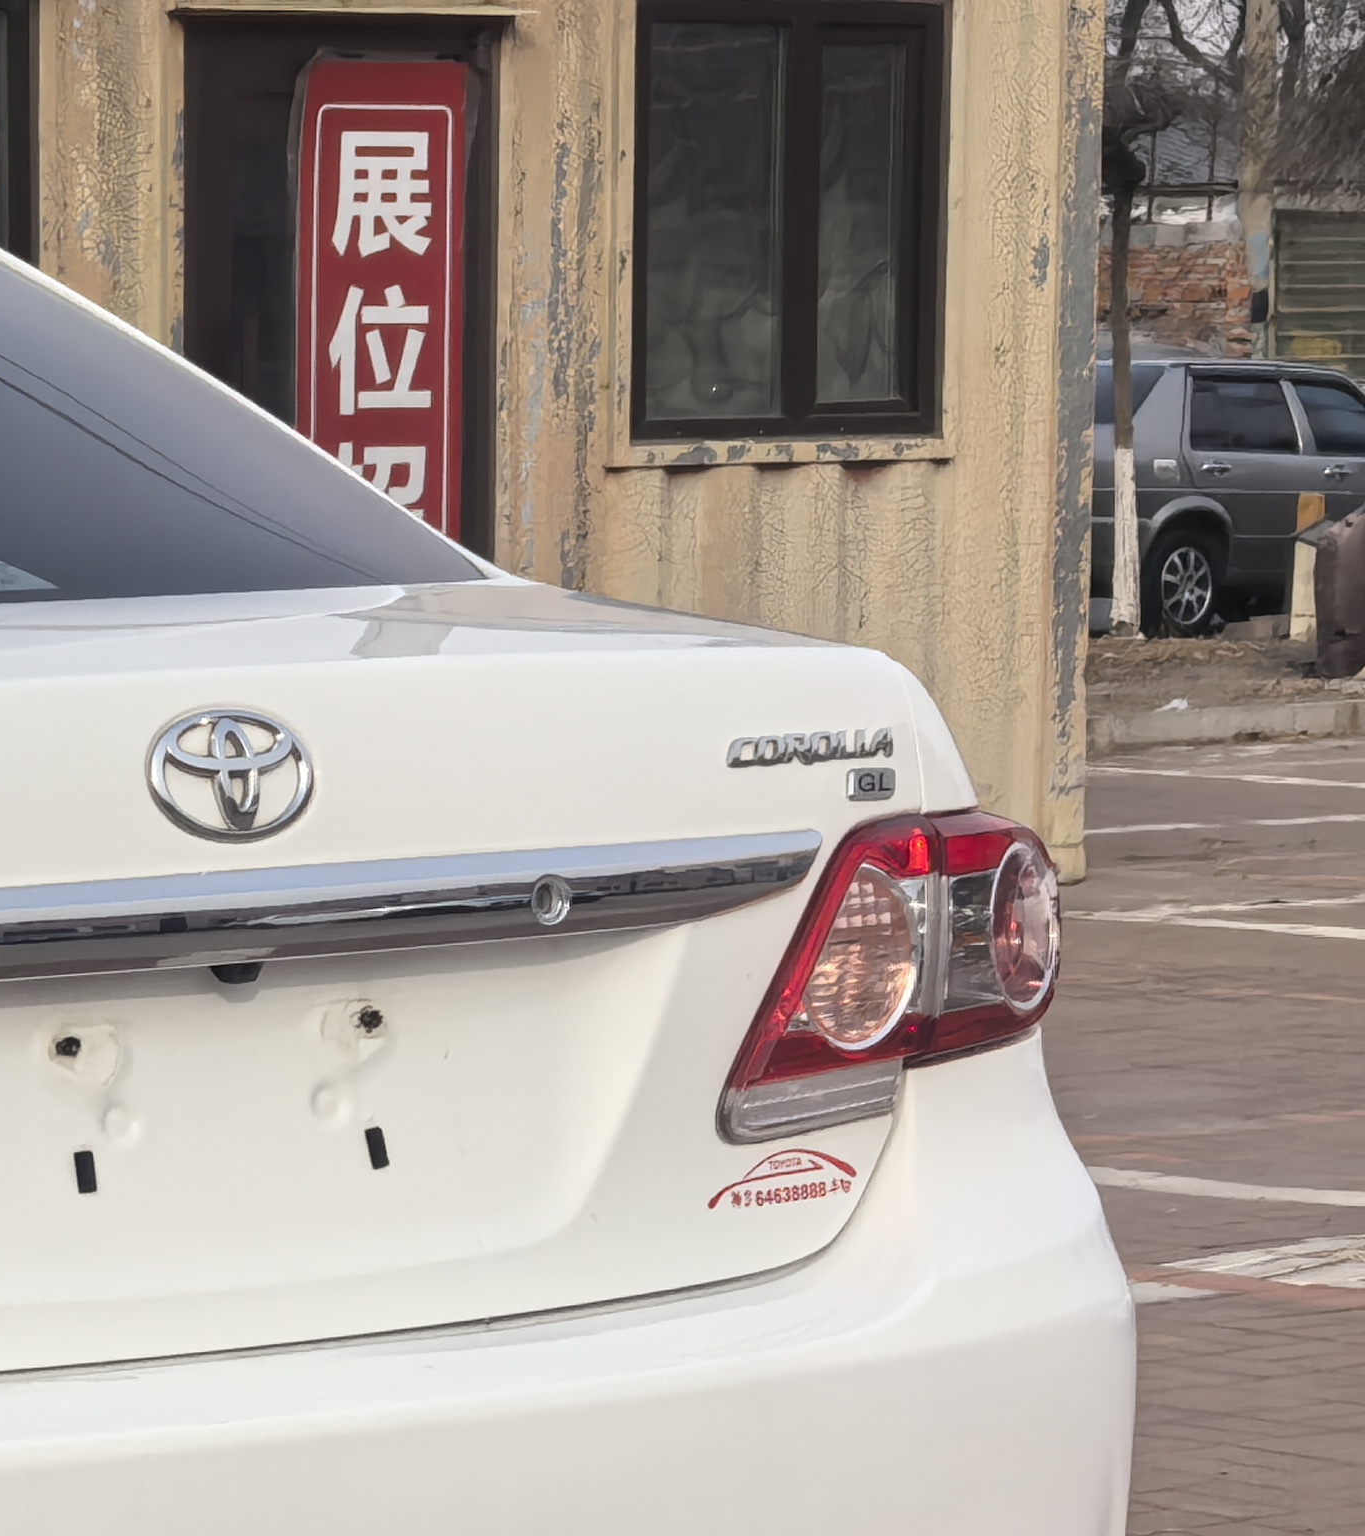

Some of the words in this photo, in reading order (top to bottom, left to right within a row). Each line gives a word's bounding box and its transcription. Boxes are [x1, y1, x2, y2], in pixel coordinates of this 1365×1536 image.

[726, 727, 894, 768] COROLLA
[857, 772, 893, 793] GL
[768, 1157, 803, 1171] TOYOTA
